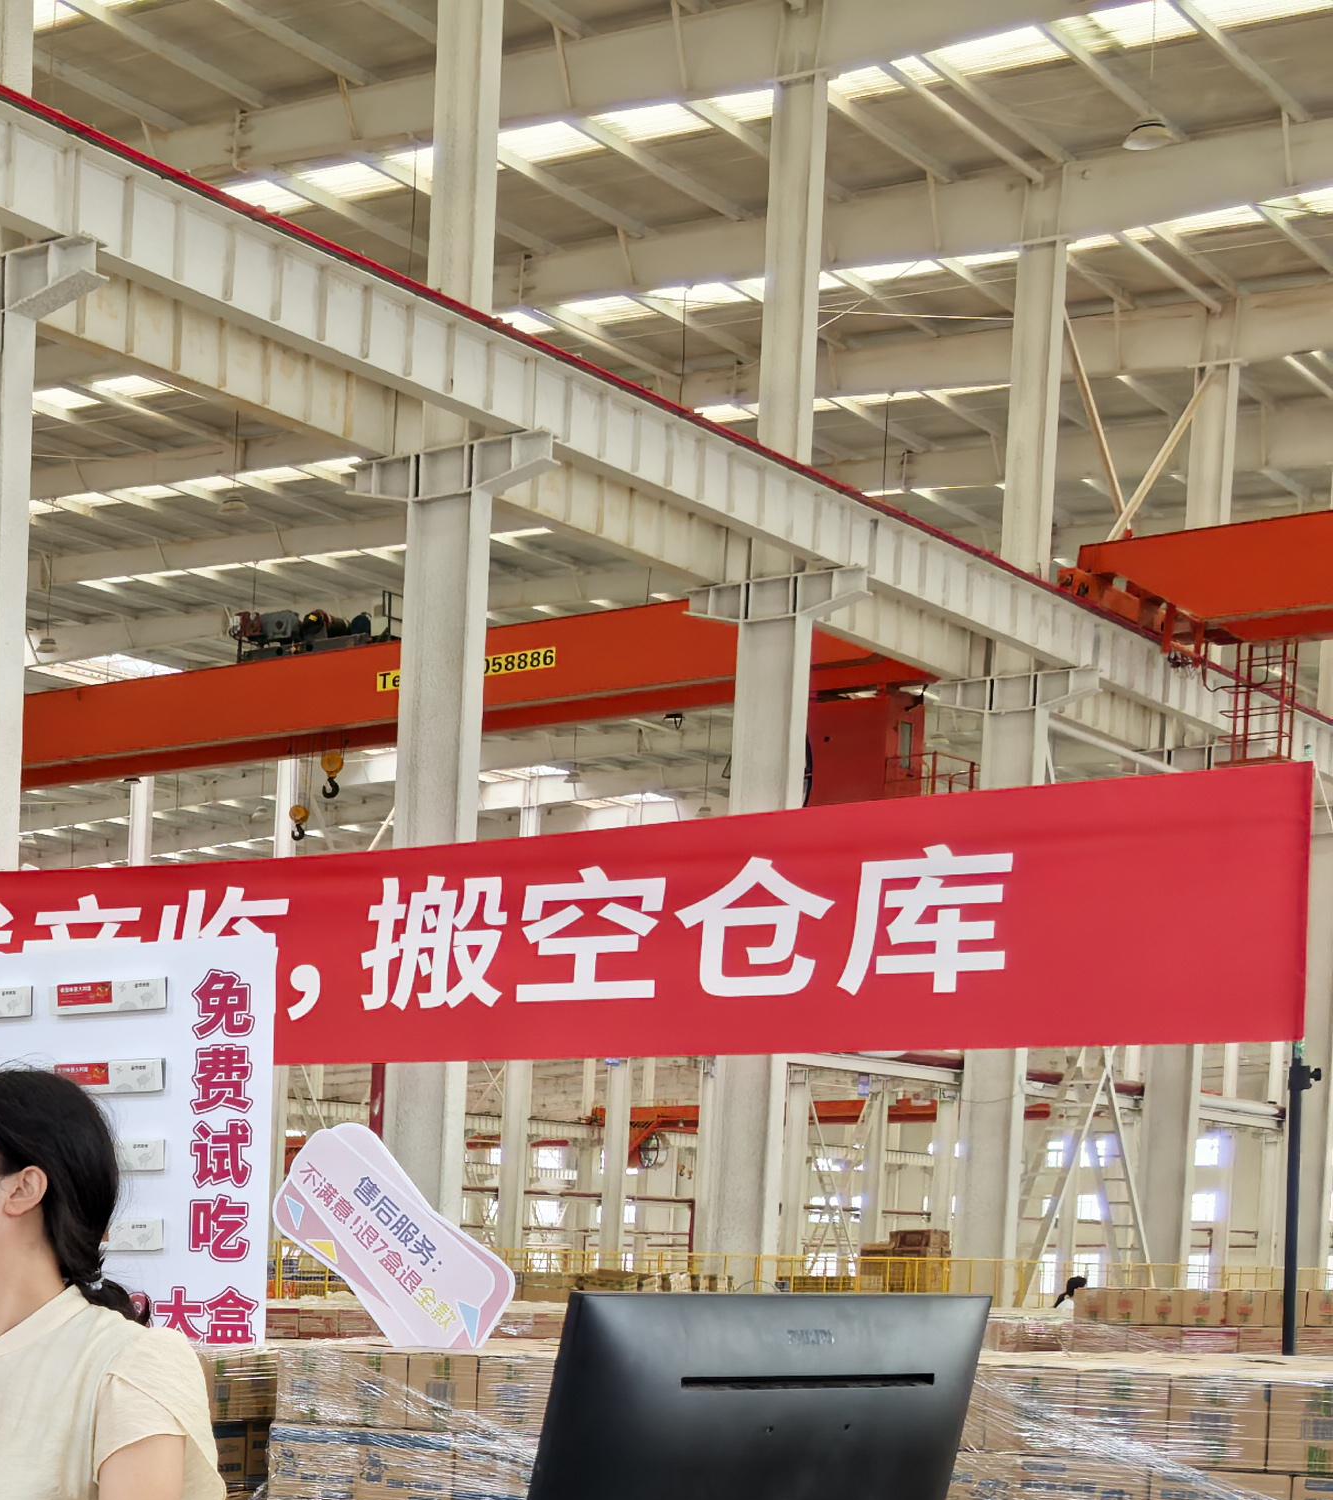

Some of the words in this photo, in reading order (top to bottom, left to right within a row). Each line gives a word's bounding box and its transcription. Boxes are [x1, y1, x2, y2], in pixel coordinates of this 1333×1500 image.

[189, 967, 257, 1263] 免费试吃
[129, 1286, 259, 1347] 大盒
